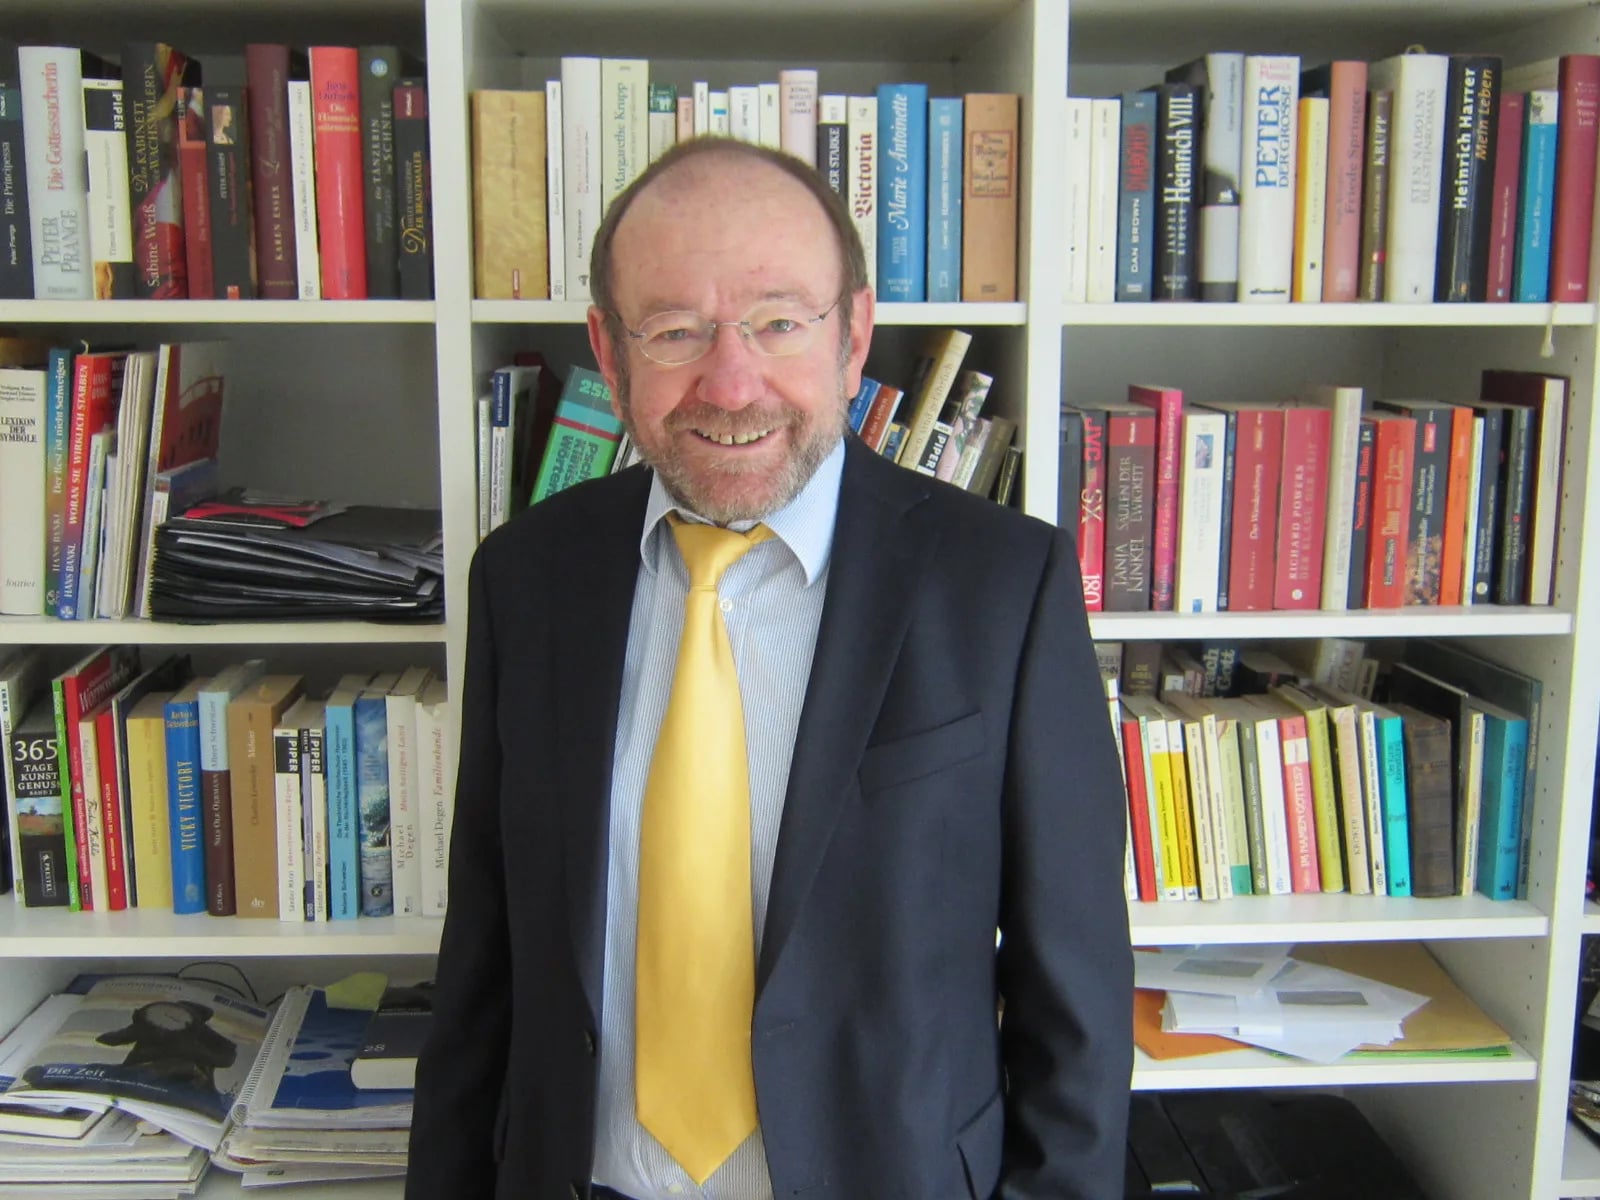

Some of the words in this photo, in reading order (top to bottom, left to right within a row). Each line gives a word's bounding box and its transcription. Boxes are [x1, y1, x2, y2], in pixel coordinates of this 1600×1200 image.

[112, 91, 123, 129] PIPER
[613, 82, 627, 121] Krupp
[1168, 92, 1193, 128] VIII.
[1458, 67, 1476, 127] Harrer
[1479, 68, 1493, 114] Leben
[41, 62, 62, 165] Gottessucherin
[133, 101, 147, 164] KABINETT
[381, 100, 392, 161] SCHNEE
[887, 92, 908, 172] Antoinette
[1280, 85, 1292, 152] GROSSE
[1345, 87, 1361, 159] Springer
[1412, 89, 1425, 159] NADOLNY
[371, 118, 382, 183] TÄNZERIN
[829, 127, 840, 168] STARKE
[1255, 85, 1280, 189] PETER
[1373, 115, 1387, 166] KRUPP
[1475, 120, 1489, 160] Mein
[2, 142, 15, 196] Principessa
[613, 125, 626, 190] Margarethe
[853, 133, 872, 218] Victoria
[1164, 129, 1192, 203] Heinrich
[1453, 133, 1472, 209] Heinrich
[46, 168, 64, 191] Die
[1344, 163, 1357, 214] Friede
[1410, 166, 1421, 203] STEN
[5, 199, 15, 215] Die
[271, 185, 281, 219] ESSEX
[888, 177, 909, 231] Marie
[1132, 198, 1140, 244] BROWN
[142, 203, 157, 240] Weiß
[1168, 207, 1176, 252] JASPER
[1532, 219, 1540, 247] Michael
[41, 217, 62, 266] PETER
[60, 209, 81, 273] PRANGE
[273, 224, 284, 261] KAREN
[1131, 247, 1139, 273] DAN
[146, 242, 160, 287] Sabine
[55, 358, 66, 410] Schweigen
[77, 364, 88, 411] STARBEN
[0, 416, 36, 426] LEXIKON
[0, 433, 38, 443] SYMBOLE
[9, 425, 26, 434] DER
[55, 411, 64, 436] nicht
[73, 412, 84, 465] WIRKLICH
[1085, 415, 1102, 461] JVC
[1165, 401, 1176, 462] Auswanderer
[54, 453, 63, 474] Rest
[55, 439, 63, 451] ist
[924, 433, 948, 469] PIPER
[71, 467, 79, 484] SIE
[1118, 455, 1132, 483] DER
[1163, 463, 1173, 480] Die
[69, 486, 79, 525] WORAN
[1082, 488, 1102, 525] SX
[1130, 463, 1144, 523] EWIGKEIT
[1293, 463, 1304, 517] POWERS
[52, 546, 61, 572] HANS
[66, 543, 76, 572] BANKL
[1111, 544, 1127, 589] TANJA
[1127, 535, 1145, 593] KINKEL
[1289, 522, 1301, 580] RICHARD
[64, 574, 74, 598] HANS
[1082, 573, 1101, 605] 180
[1217, 648, 1236, 691] Gott
[15, 739, 58, 762] 365
[24, 763, 54, 773] TAGE
[209, 745, 218, 768] Albert
[288, 740, 298, 772] PIPER
[311, 740, 320, 772] PIPER
[20, 772, 58, 782] KUNST
[177, 760, 195, 811] VICTORY
[211, 773, 221, 811] OERMANN
[1294, 765, 1307, 813] GOTTES?
[180, 816, 198, 851] VICKY
[213, 814, 221, 829] OLE
[435, 801, 446, 831] Degen
[1297, 816, 1308, 852] NAMEN
[88, 826, 100, 857] Kahlo
[397, 824, 405, 869] Michael
[405, 824, 414, 858] Degen
[434, 834, 445, 869] Michael
[1300, 854, 1310, 867] IM
[1257, 874, 1266, 888] dtv
[47, 1065, 71, 1076] Die
[77, 1066, 105, 1078] Zeit
